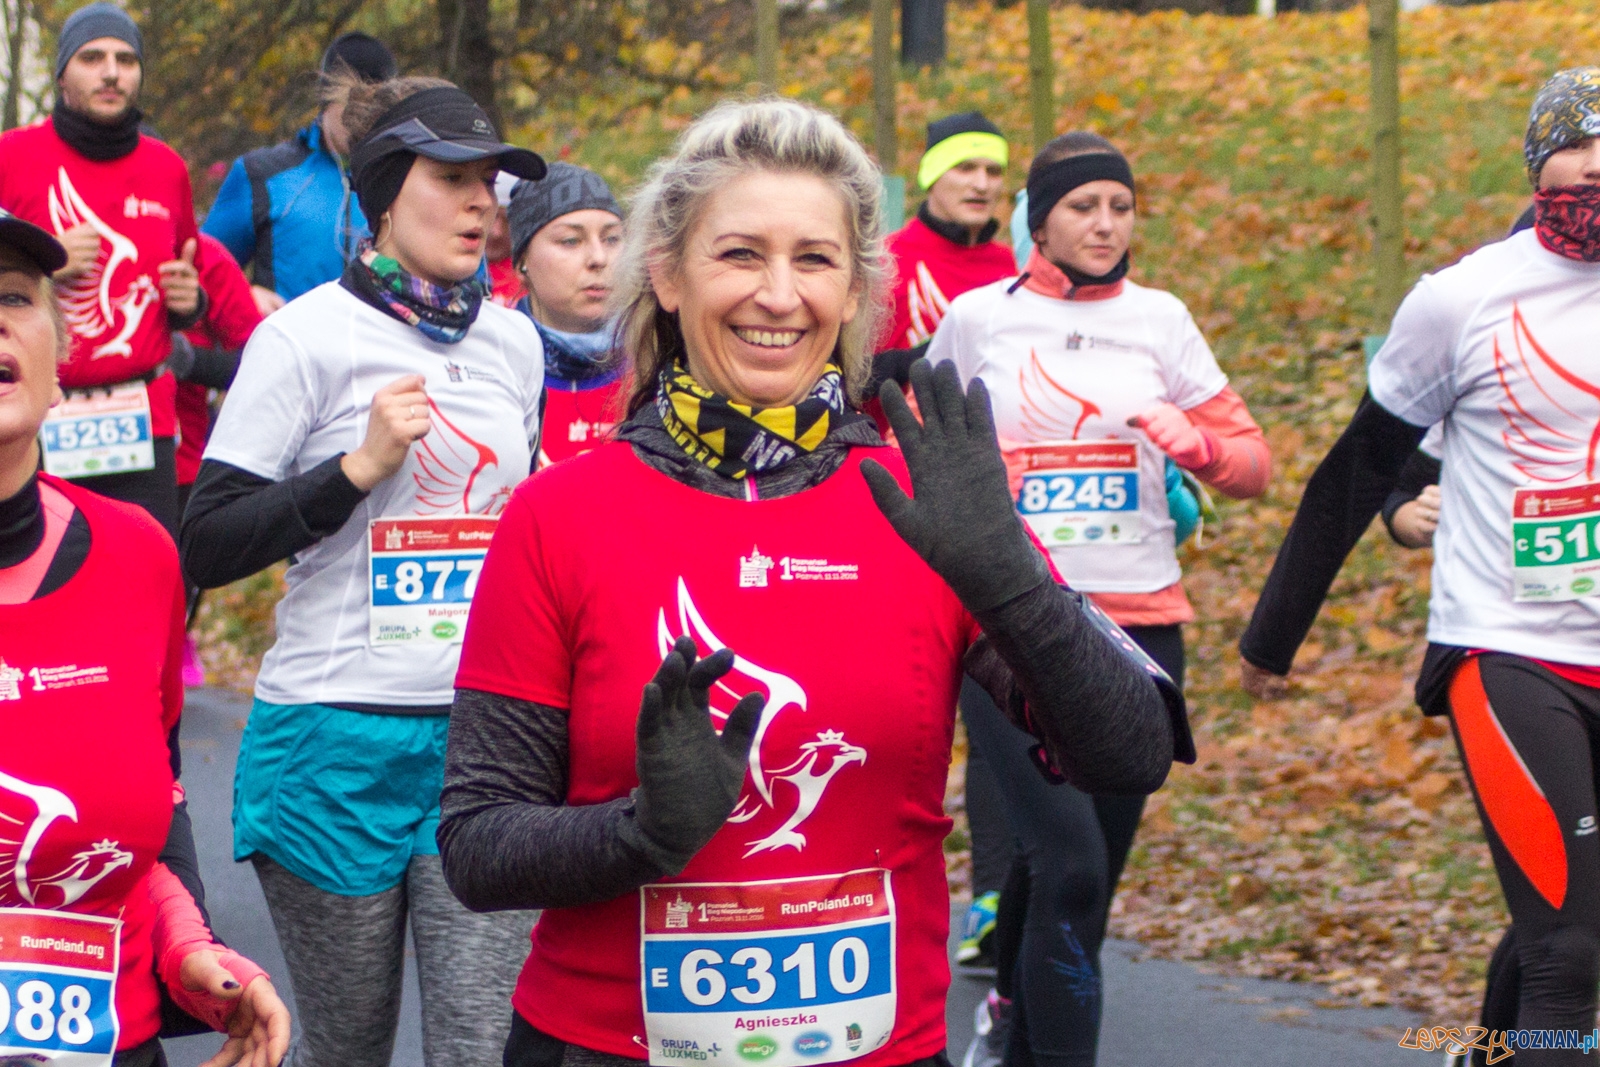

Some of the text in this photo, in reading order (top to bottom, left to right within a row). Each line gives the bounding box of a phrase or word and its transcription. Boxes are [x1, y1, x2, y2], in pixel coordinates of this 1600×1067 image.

[59, 416, 139, 450] 5263
[1022, 475, 1127, 512] 8245
[1516, 521, 1600, 563] C 51
[375, 559, 484, 601] E 877
[780, 556, 794, 580] 1
[28, 666, 47, 691] 1
[698, 902, 710, 922] 1
[781, 893, 874, 915] RunPoland.org
[20, 935, 104, 960] RunPoland.org
[652, 936, 870, 1006] E 6310
[0, 980, 94, 1045] 88
[734, 1012, 818, 1031] Agnieszka
[661, 1038, 699, 1050] GRUPA
[662, 1048, 707, 1061] LUXMED
